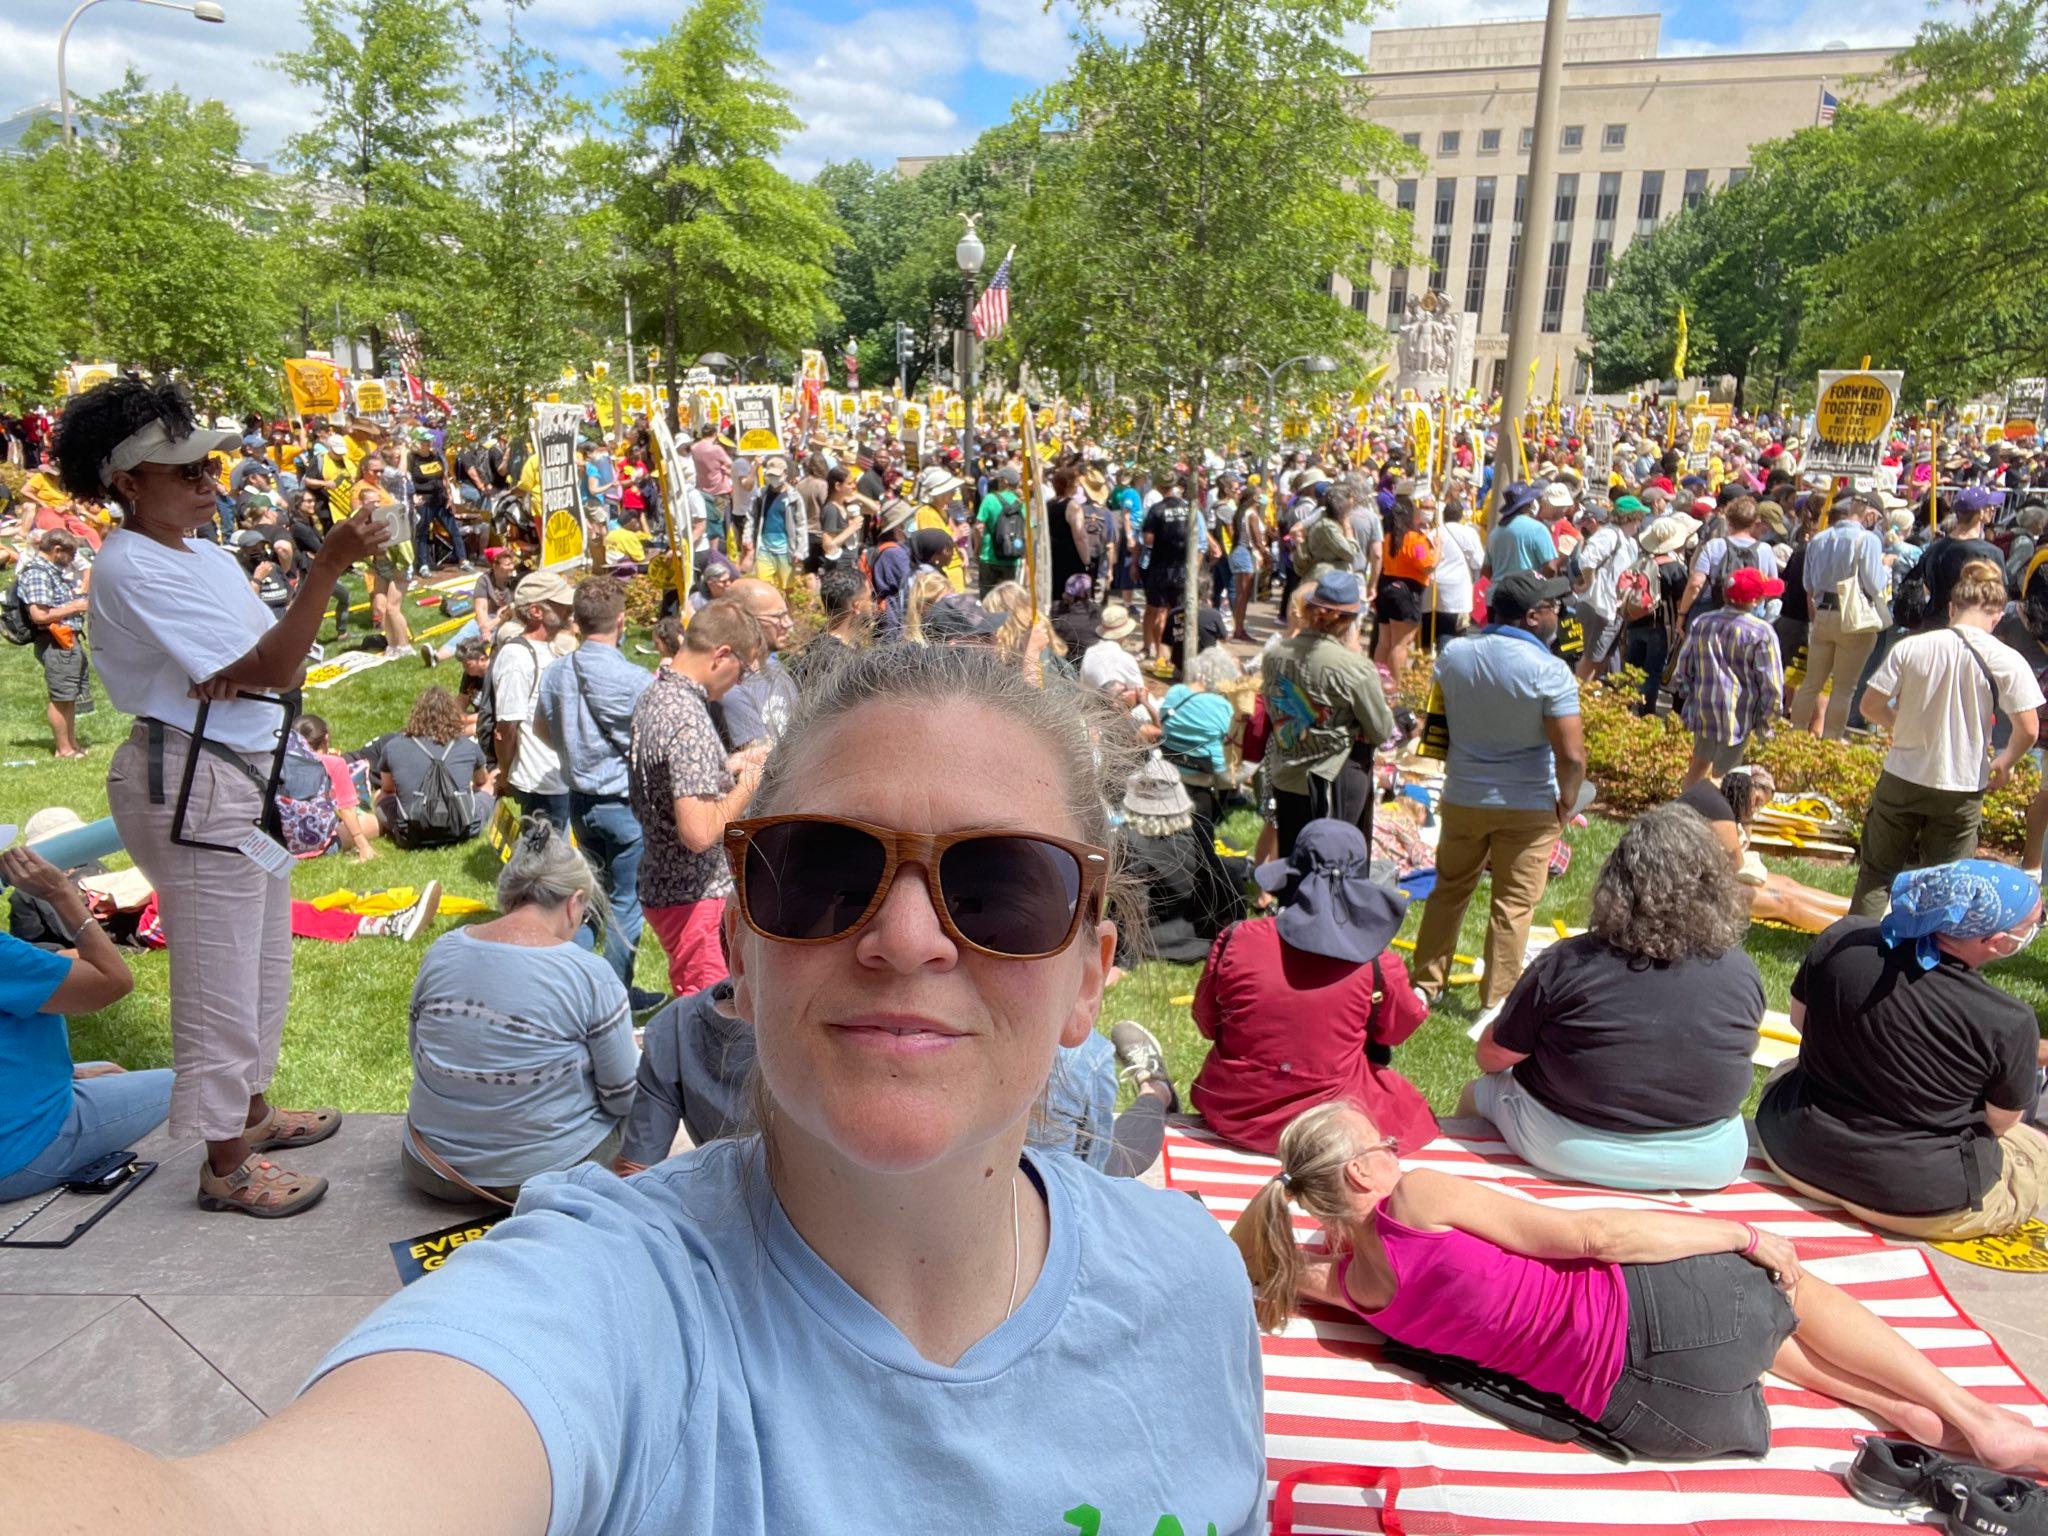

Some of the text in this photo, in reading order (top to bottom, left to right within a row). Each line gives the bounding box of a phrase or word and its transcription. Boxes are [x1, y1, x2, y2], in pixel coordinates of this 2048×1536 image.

[1830, 385, 1884, 400] FORWARD
[1824, 402, 1882, 416] TOGETHER!
[409, 1225, 493, 1259] EVER
[1976, 1518, 2008, 1536] AIR
